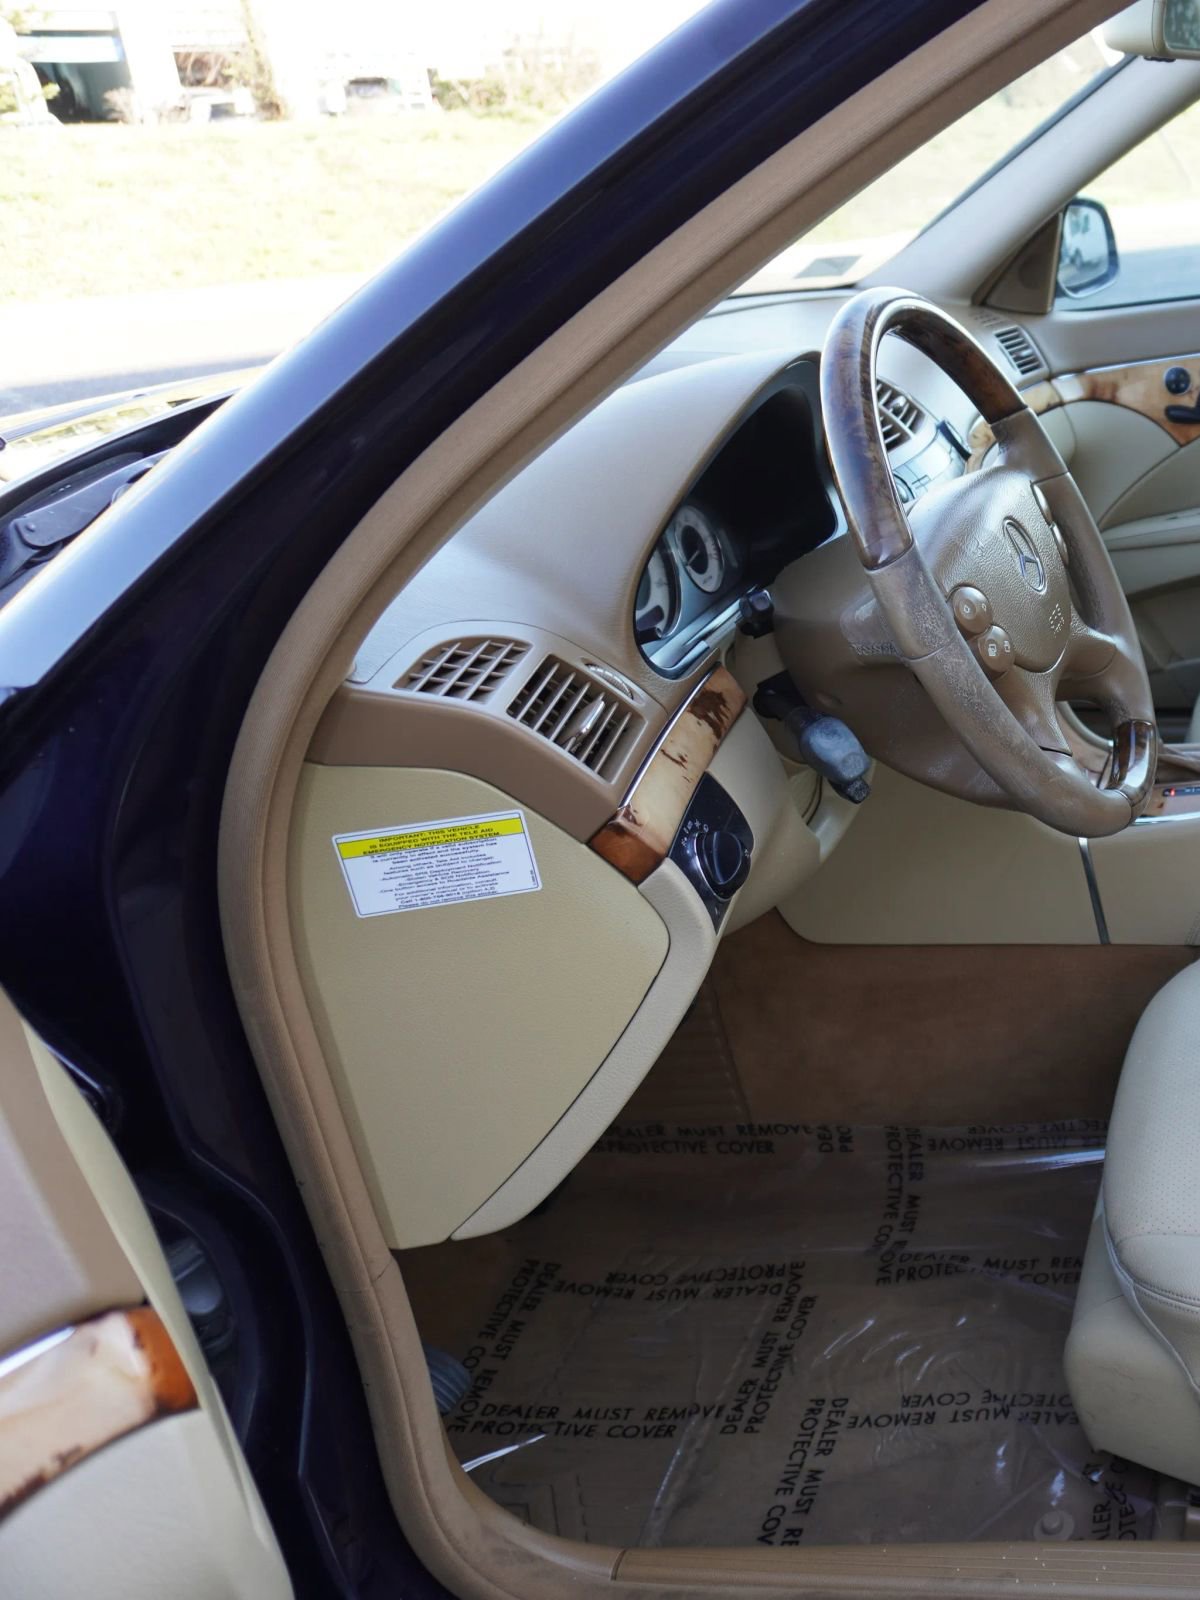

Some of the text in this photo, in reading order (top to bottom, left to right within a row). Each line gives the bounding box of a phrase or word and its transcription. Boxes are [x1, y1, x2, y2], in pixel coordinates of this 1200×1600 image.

[363, 845, 411, 855] EMERGENCY
[414, 837, 467, 847] NOTIFICATION
[379, 833, 424, 843] IMPORTANT:
[379, 839, 418, 848] EQUIPPED
[677, 1124, 724, 1137] MUST
[716, 1140, 775, 1154] COVER
[928, 1136, 1004, 1151] REMOVE
[899, 1194, 920, 1234] MUST
[983, 1256, 1040, 1271] MUST
[605, 1271, 669, 1286] COVER
[552, 1280, 783, 1302] REMOVE MUST DEALER
[787, 1294, 819, 1341] COVER
[491, 1319, 526, 1361] MUST
[720, 1260, 805, 1434] DEALER MUST REMOVE
[902, 1391, 970, 1407] COVER
[480, 1402, 560, 1419] DEALER
[574, 1406, 635, 1421] MUST
[847, 1409, 936, 1429] REMOVE
[950, 1406, 1010, 1424] MUST
[470, 1419, 678, 1439] PROTECTIVE COVER
[814, 1398, 849, 1457] DEALER
[775, 1398, 826, 1496] PROTECTIVE
[792, 1469, 825, 1515] MUST
